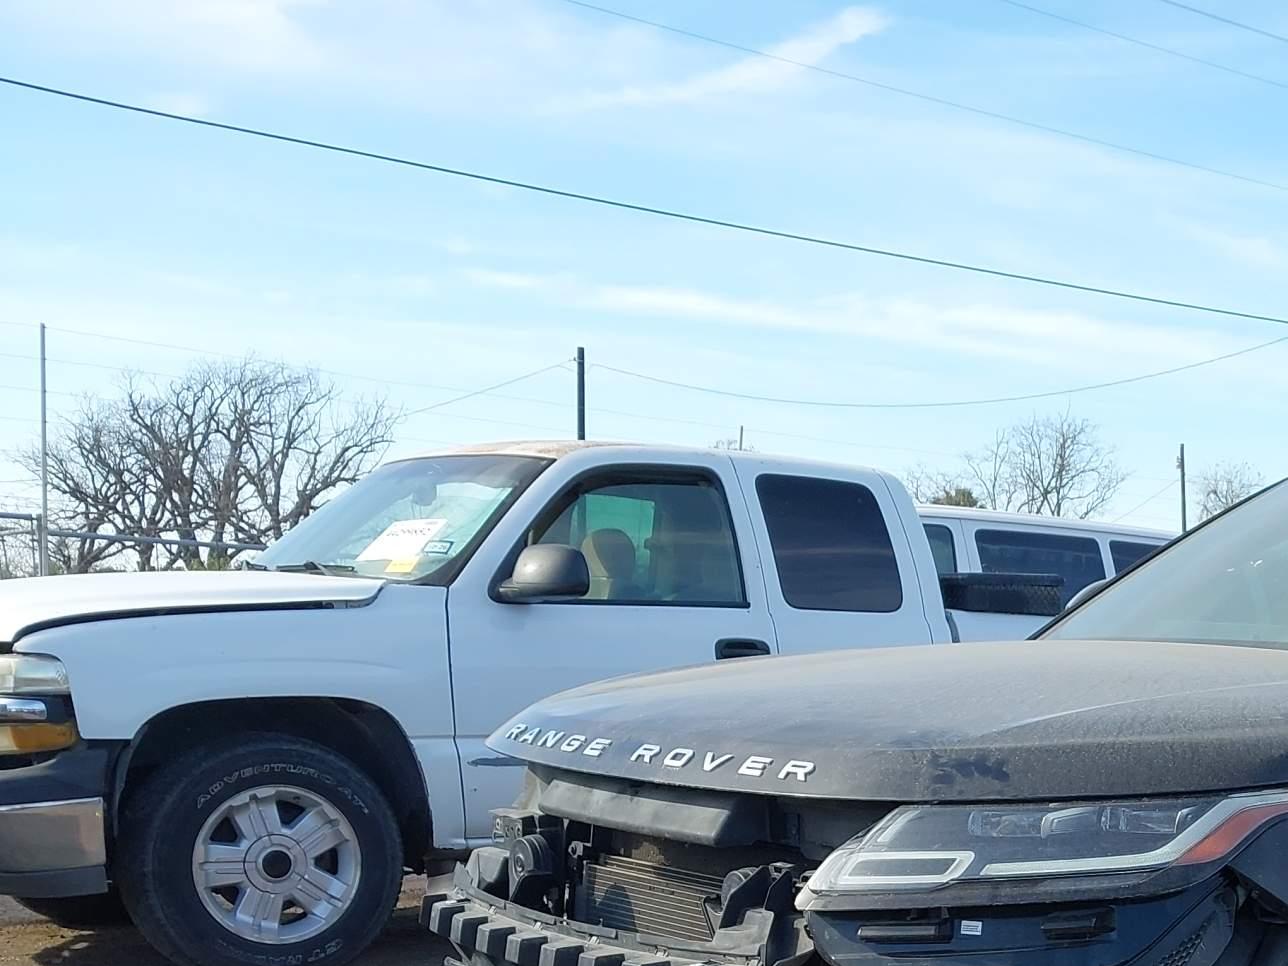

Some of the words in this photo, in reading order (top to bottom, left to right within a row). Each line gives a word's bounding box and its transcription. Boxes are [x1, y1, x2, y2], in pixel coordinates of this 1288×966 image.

[505, 723, 612, 758] RANGE
[630, 743, 817, 783] ROVER
[197, 763, 337, 809] ADVENTURO
